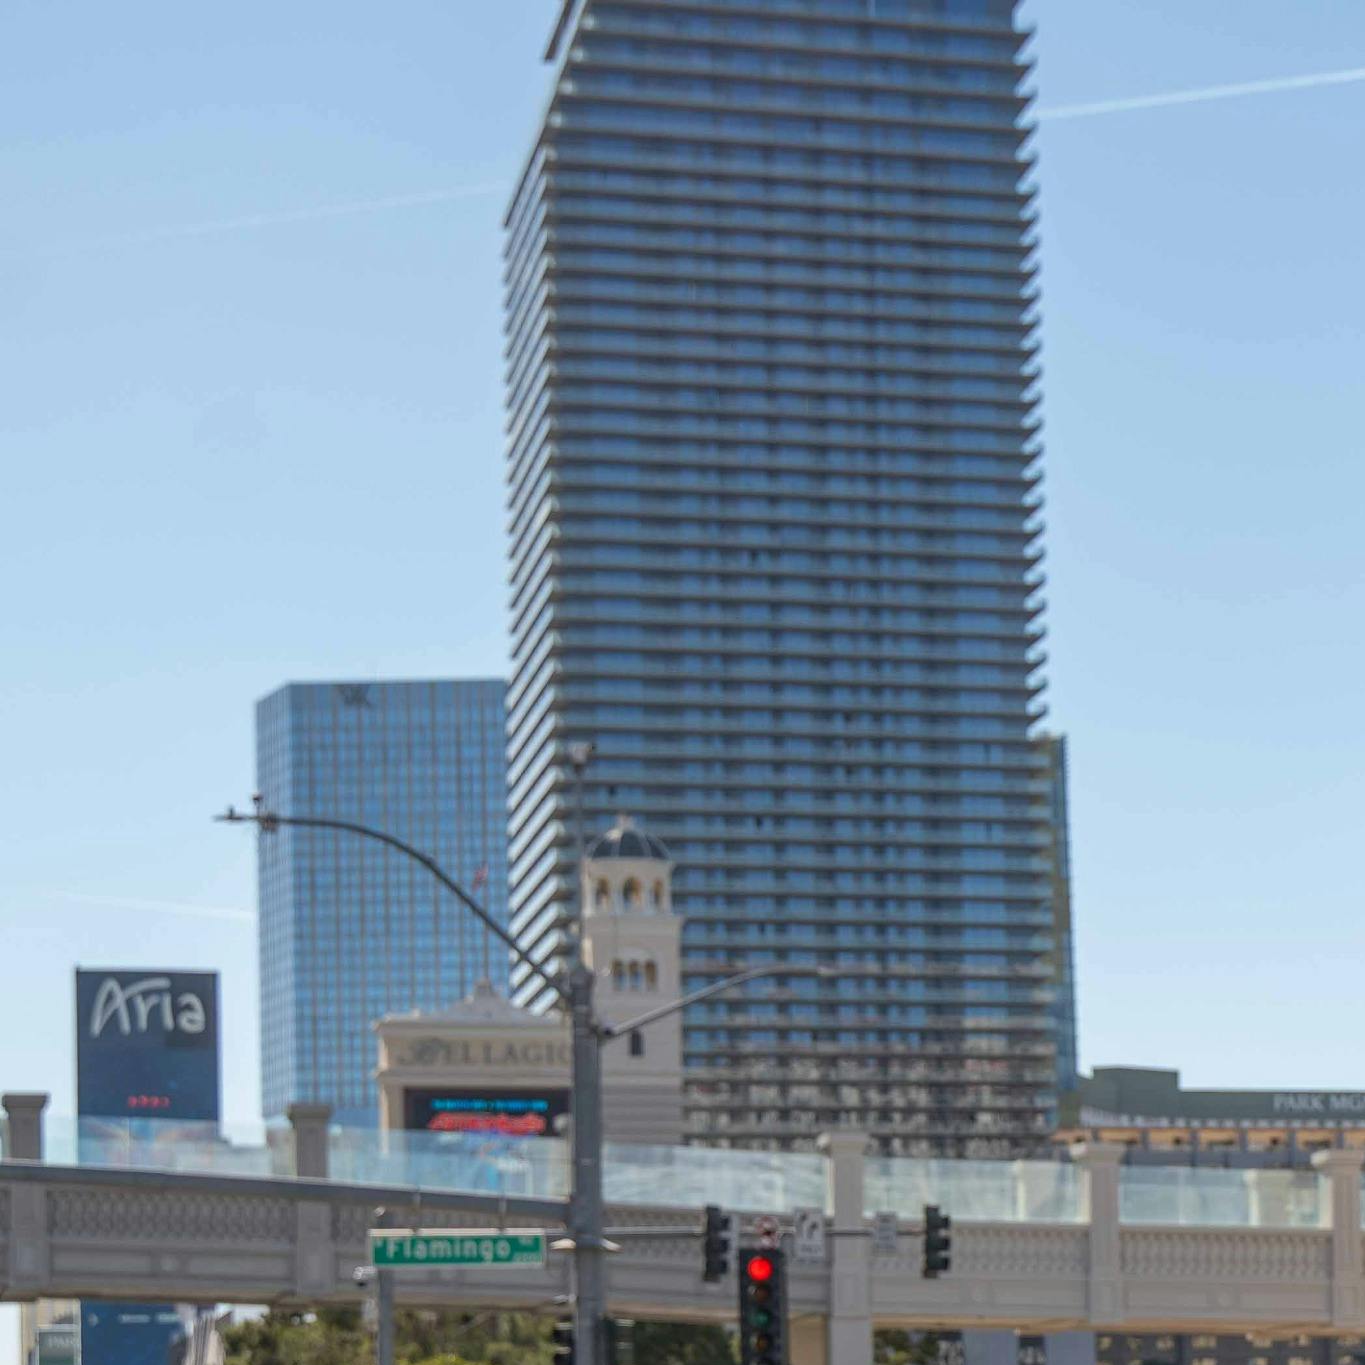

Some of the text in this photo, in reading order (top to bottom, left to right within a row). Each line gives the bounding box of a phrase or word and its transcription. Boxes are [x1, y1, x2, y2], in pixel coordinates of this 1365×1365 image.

[89, 976, 207, 1038] Aria
[1272, 1093, 1326, 1112] PARK
[385, 1237, 511, 1263] Flamingo
